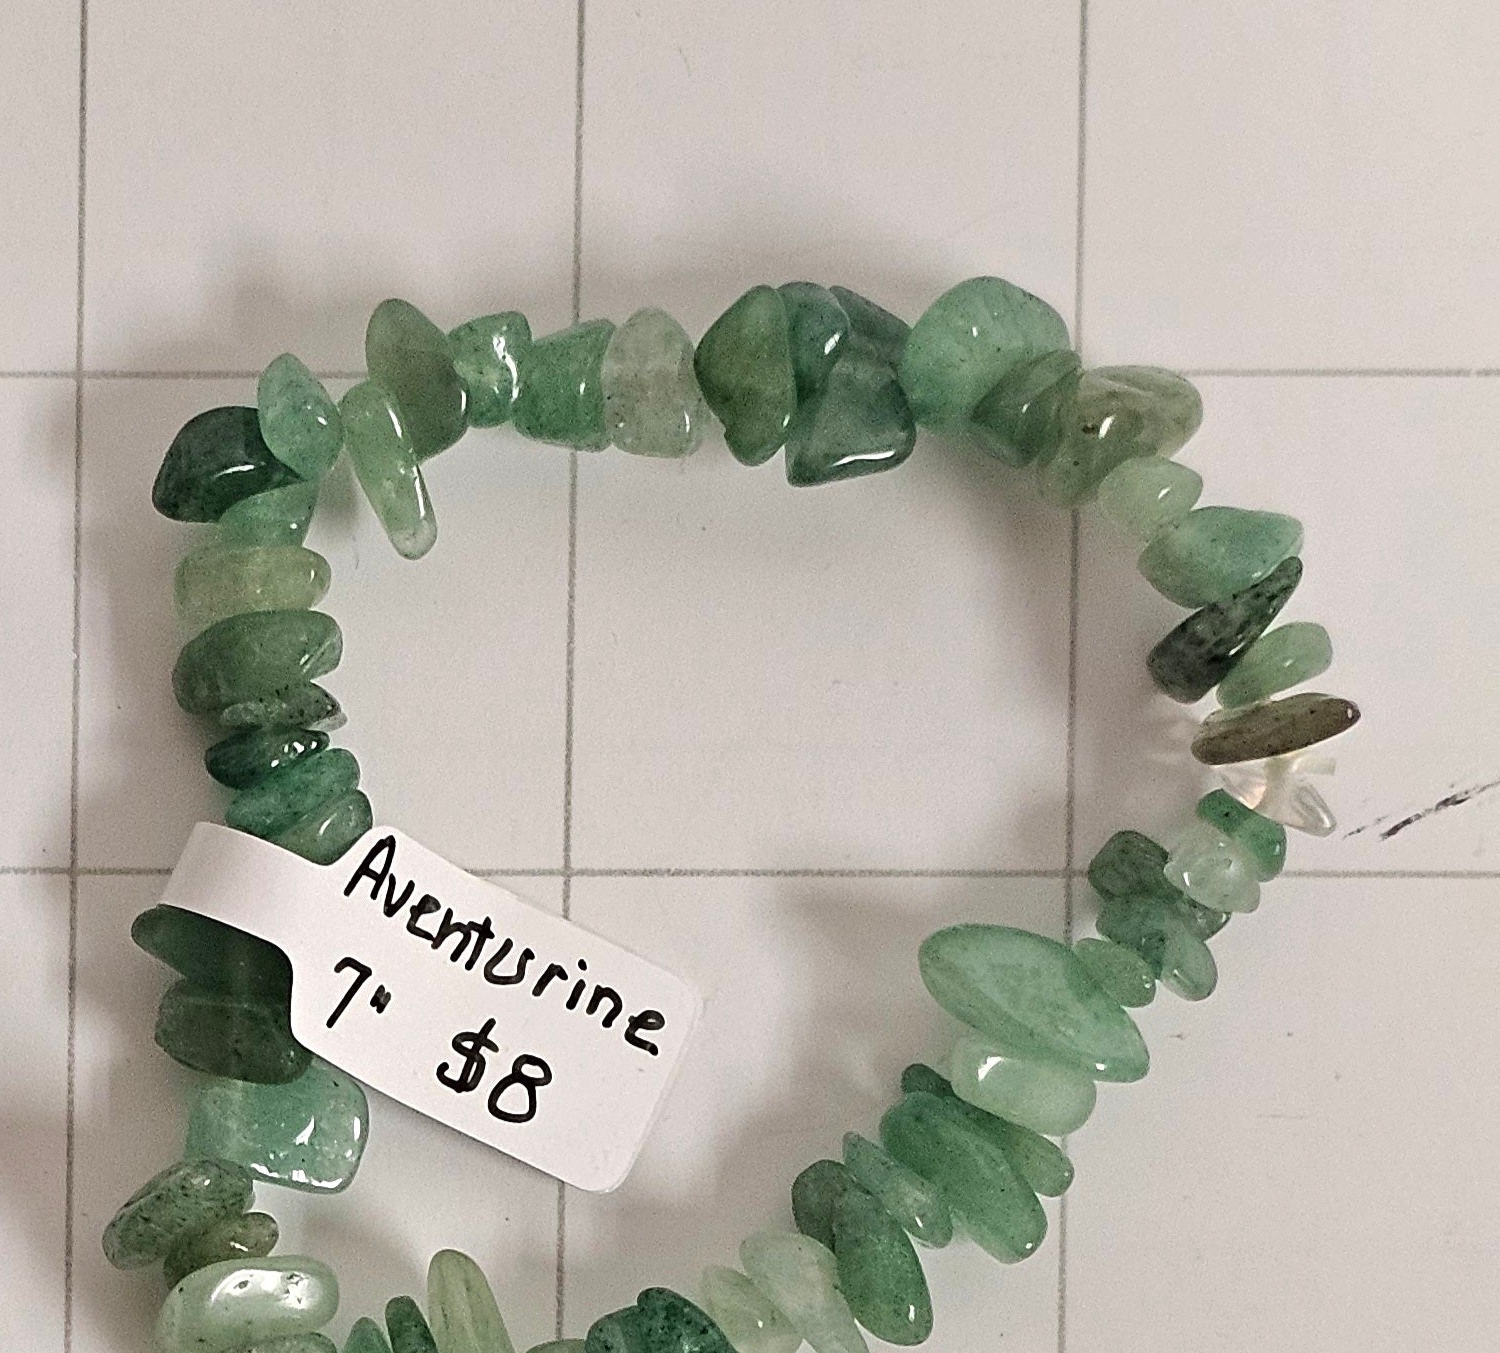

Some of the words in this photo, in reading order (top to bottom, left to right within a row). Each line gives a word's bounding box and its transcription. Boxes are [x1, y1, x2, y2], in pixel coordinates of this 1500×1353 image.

[324, 955, 393, 1030] 7"
[434, 1016, 554, 1125] $8
[342, 833, 667, 1057] Aventurine
